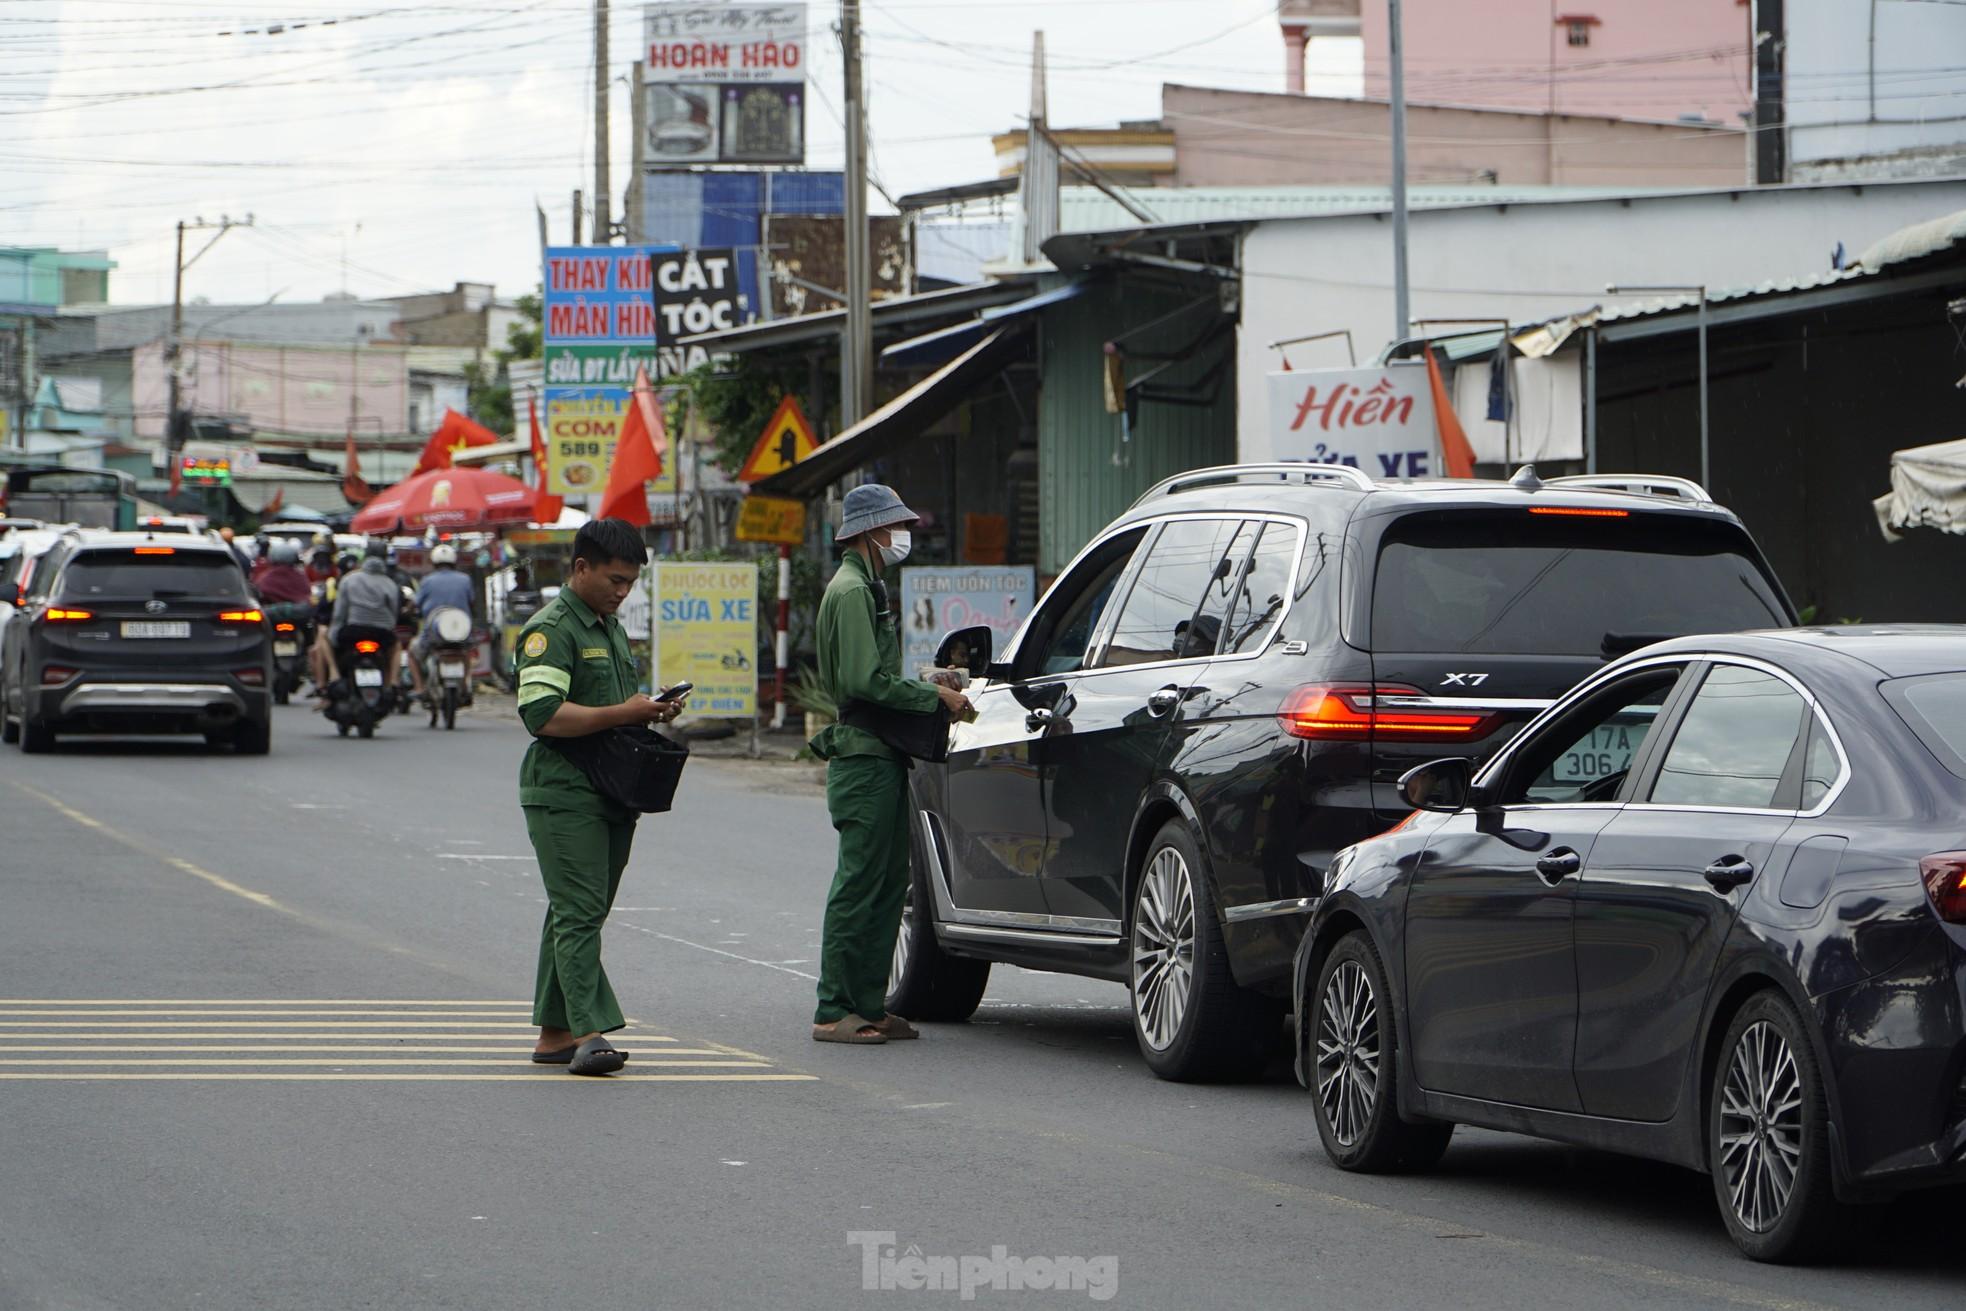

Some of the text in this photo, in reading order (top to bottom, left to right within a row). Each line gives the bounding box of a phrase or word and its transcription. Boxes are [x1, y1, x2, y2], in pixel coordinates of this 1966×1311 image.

[550, 256, 609, 291] THAY
[657, 250, 729, 293] CẮT
[550, 294, 609, 336] MÀN
[661, 297, 733, 334] TÓC
[1289, 377, 1414, 432] Hiền
[661, 593, 712, 622] SỬA
[720, 599, 752, 622] XE
[1440, 673, 1489, 686] X7
